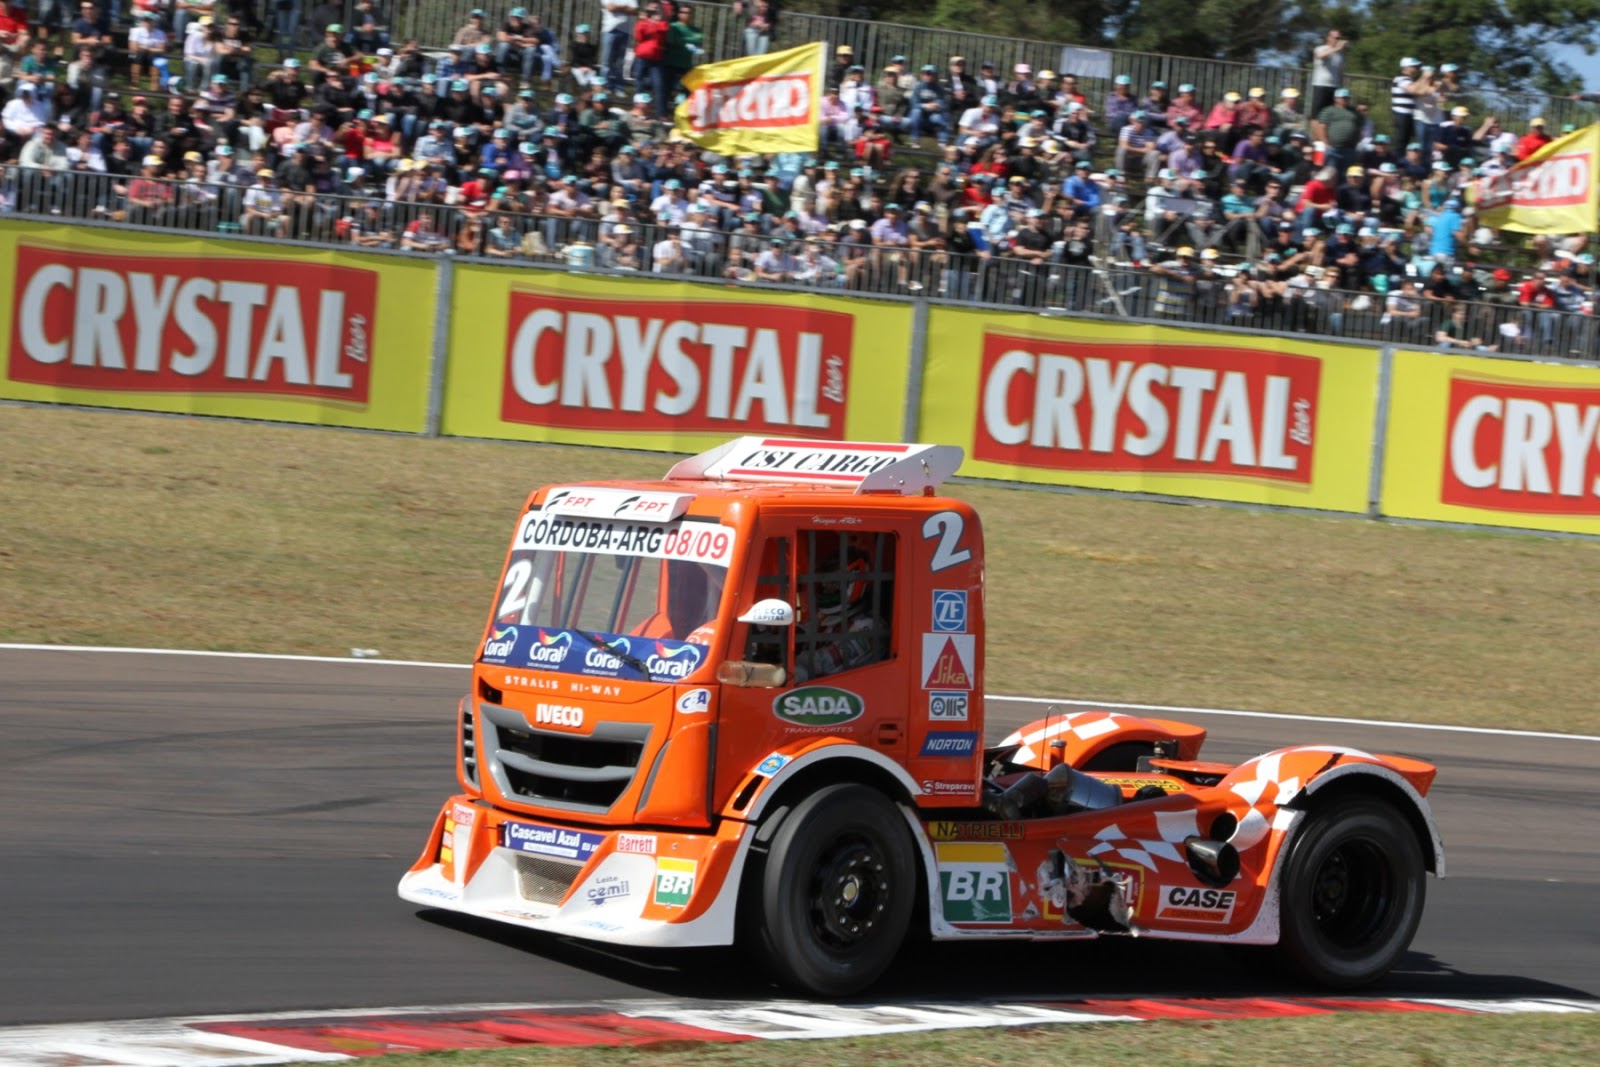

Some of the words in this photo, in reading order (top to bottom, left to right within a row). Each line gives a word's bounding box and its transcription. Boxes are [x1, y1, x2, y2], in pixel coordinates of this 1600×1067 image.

[20, 264, 353, 389] CRYSTAL
[511, 308, 830, 429] CRYSTAL
[983, 350, 1298, 470] CRYSTAL
[1451, 394, 1600, 498] CRY
[740, 449, 797, 469] CSI
[793, 453, 897, 473] CARGO
[564, 496, 595, 508] FPT
[634, 501, 669, 513] FPT
[664, 529, 729, 560] 08/09
[922, 510, 971, 572] 2
[499, 559, 532, 618] 2
[937, 600, 964, 622] ZF
[484, 638, 510, 657] Coral
[529, 642, 564, 663] Coral
[646, 654, 689, 677] Coral
[932, 655, 966, 684] Sika
[504, 674, 559, 690] STRALIS
[571, 683, 621, 697] HI-WAY
[536, 703, 584, 728] IVECO
[784, 696, 852, 716] SADA
[784, 726, 854, 734] TRANSPORTES
[927, 738, 973, 750] NORTON
[934, 782, 976, 791] Streparava
[511, 824, 557, 844] Cascavel
[556, 830, 581, 848] Azul
[937, 821, 1025, 839] NATRIELLI
[619, 835, 653, 852] Garrett
[587, 880, 630, 899] cemil
[596, 876, 619, 884] Leite
[658, 873, 692, 895] BR
[945, 870, 1004, 901] BR
[1168, 887, 1235, 909] CASE
